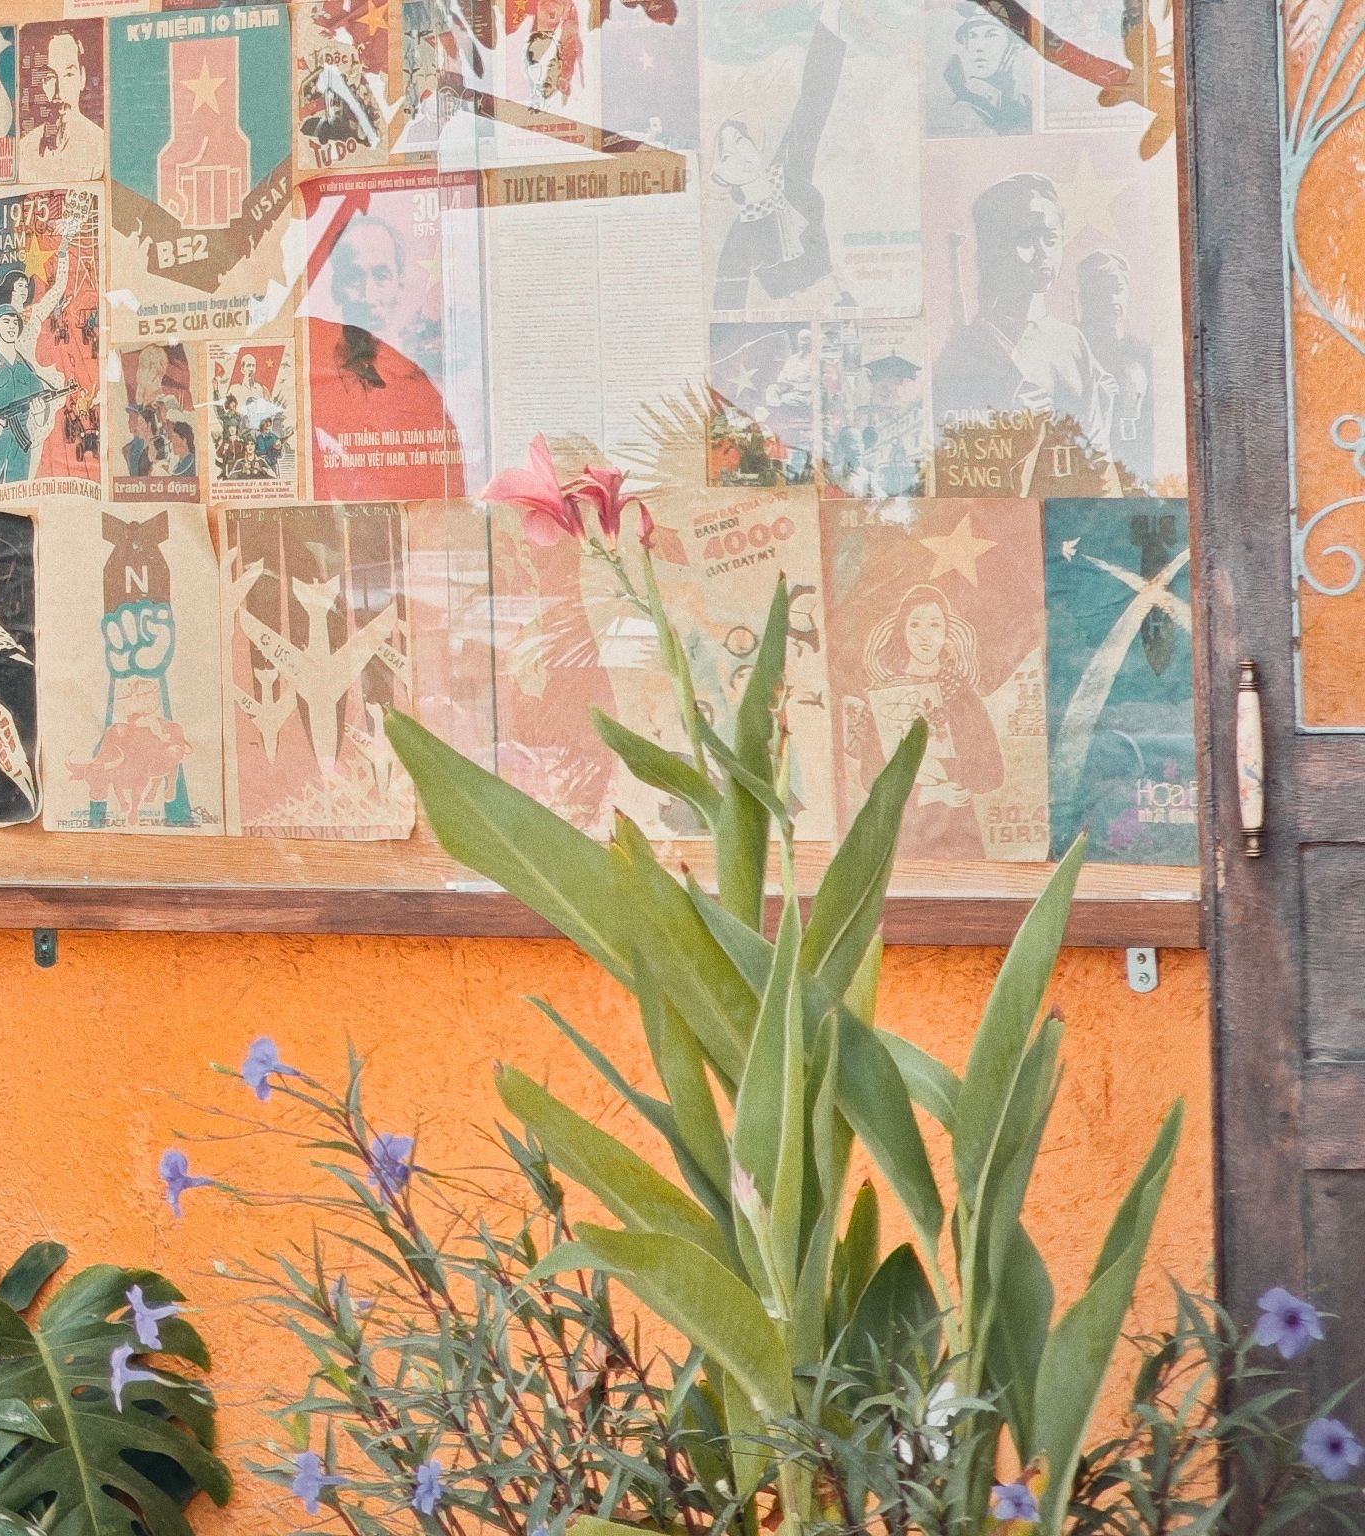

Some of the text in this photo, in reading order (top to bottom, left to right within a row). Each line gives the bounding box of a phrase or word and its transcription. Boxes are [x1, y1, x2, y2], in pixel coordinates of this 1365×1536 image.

[211, 14, 230, 33] 10
[251, 176, 287, 222] USAF
[703, 516, 795, 560] 4000
[125, 565, 149, 594] N
